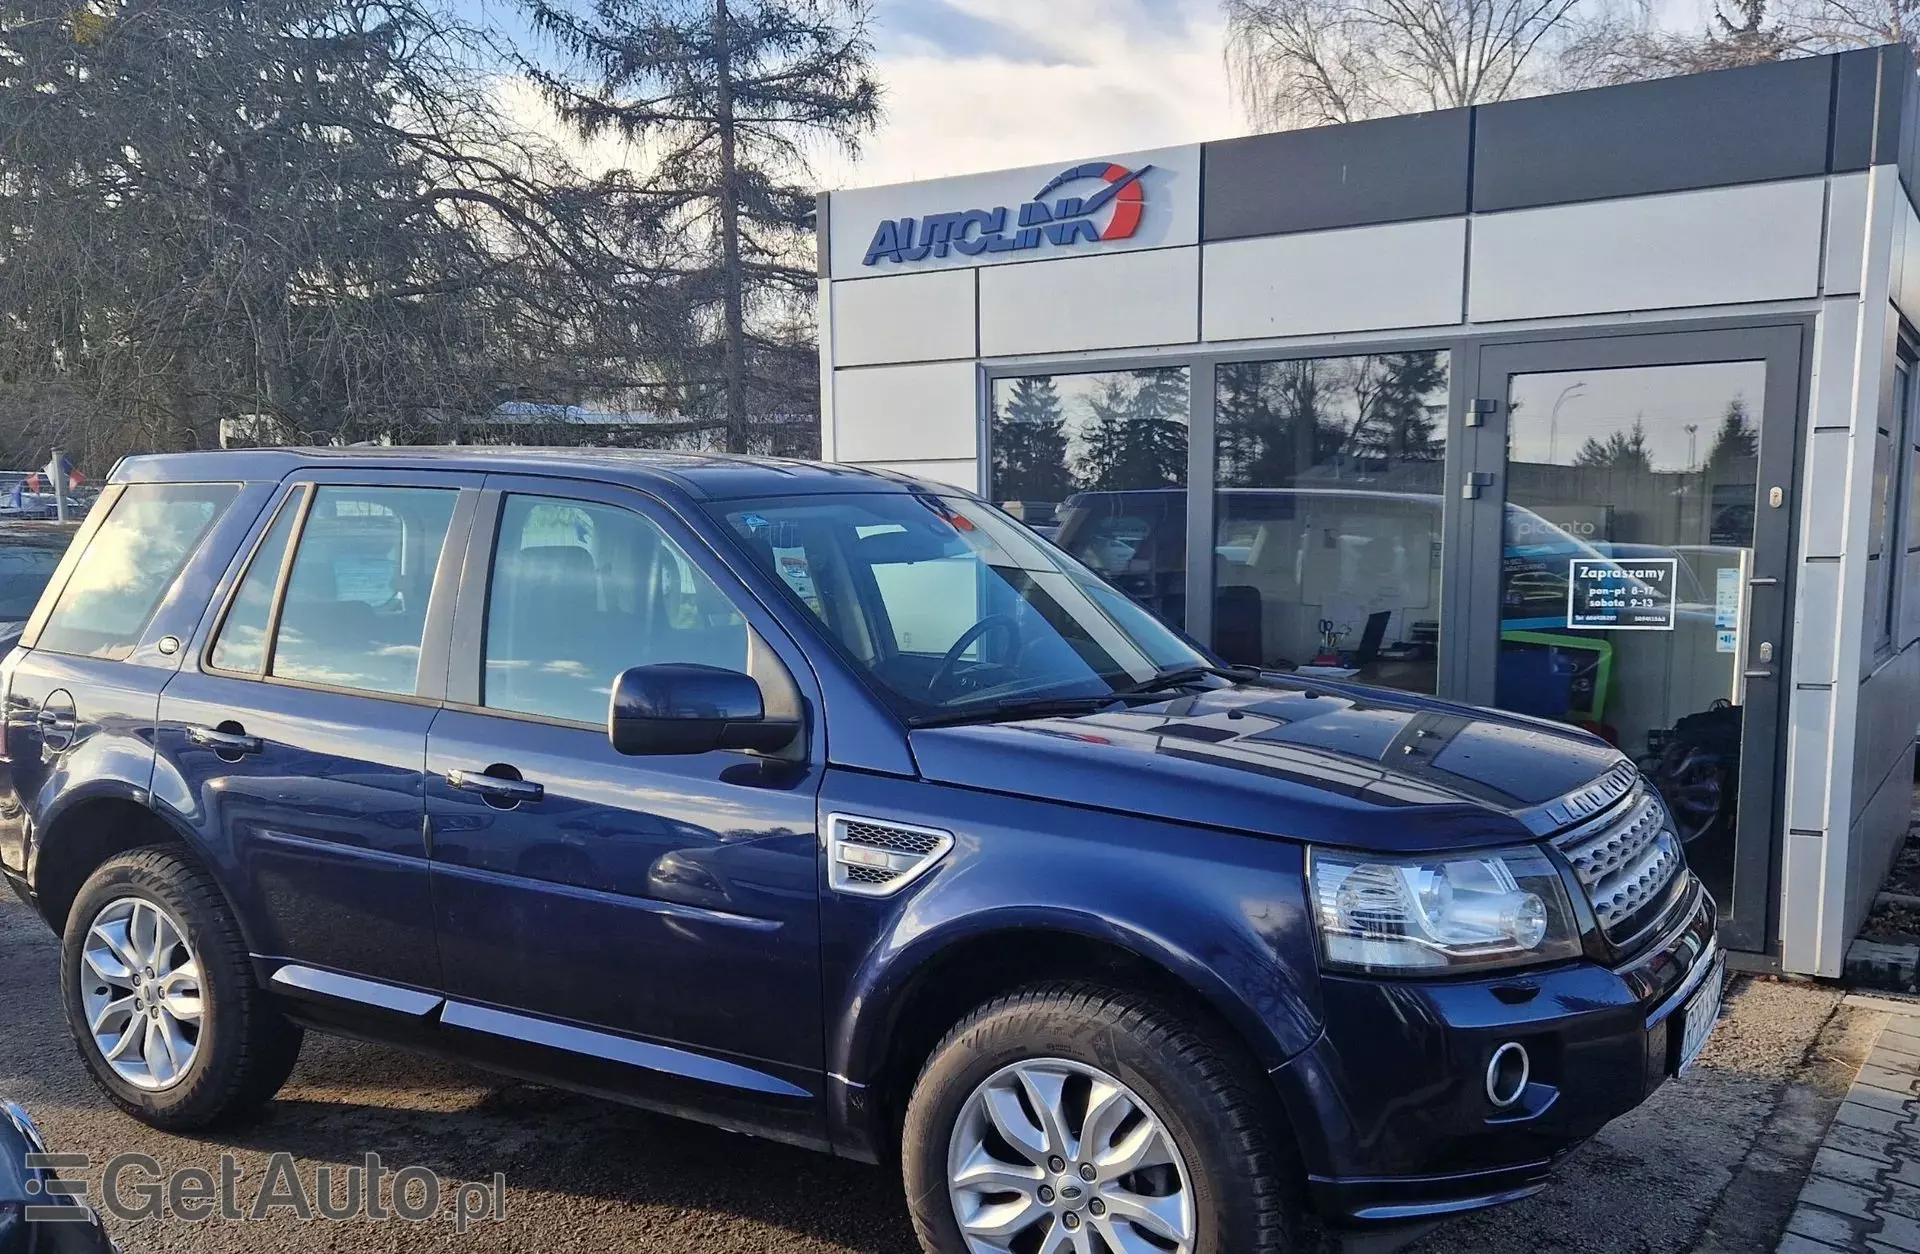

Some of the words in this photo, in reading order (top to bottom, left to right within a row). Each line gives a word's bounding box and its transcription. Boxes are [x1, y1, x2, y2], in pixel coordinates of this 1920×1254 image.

[862, 197, 1101, 266] AUTOLINK
[1580, 566, 1665, 581] Zapraszamy
[1589, 598, 1625, 607] sobota
[1630, 598, 1654, 608] 9-13
[1545, 784, 1603, 826] LAND
